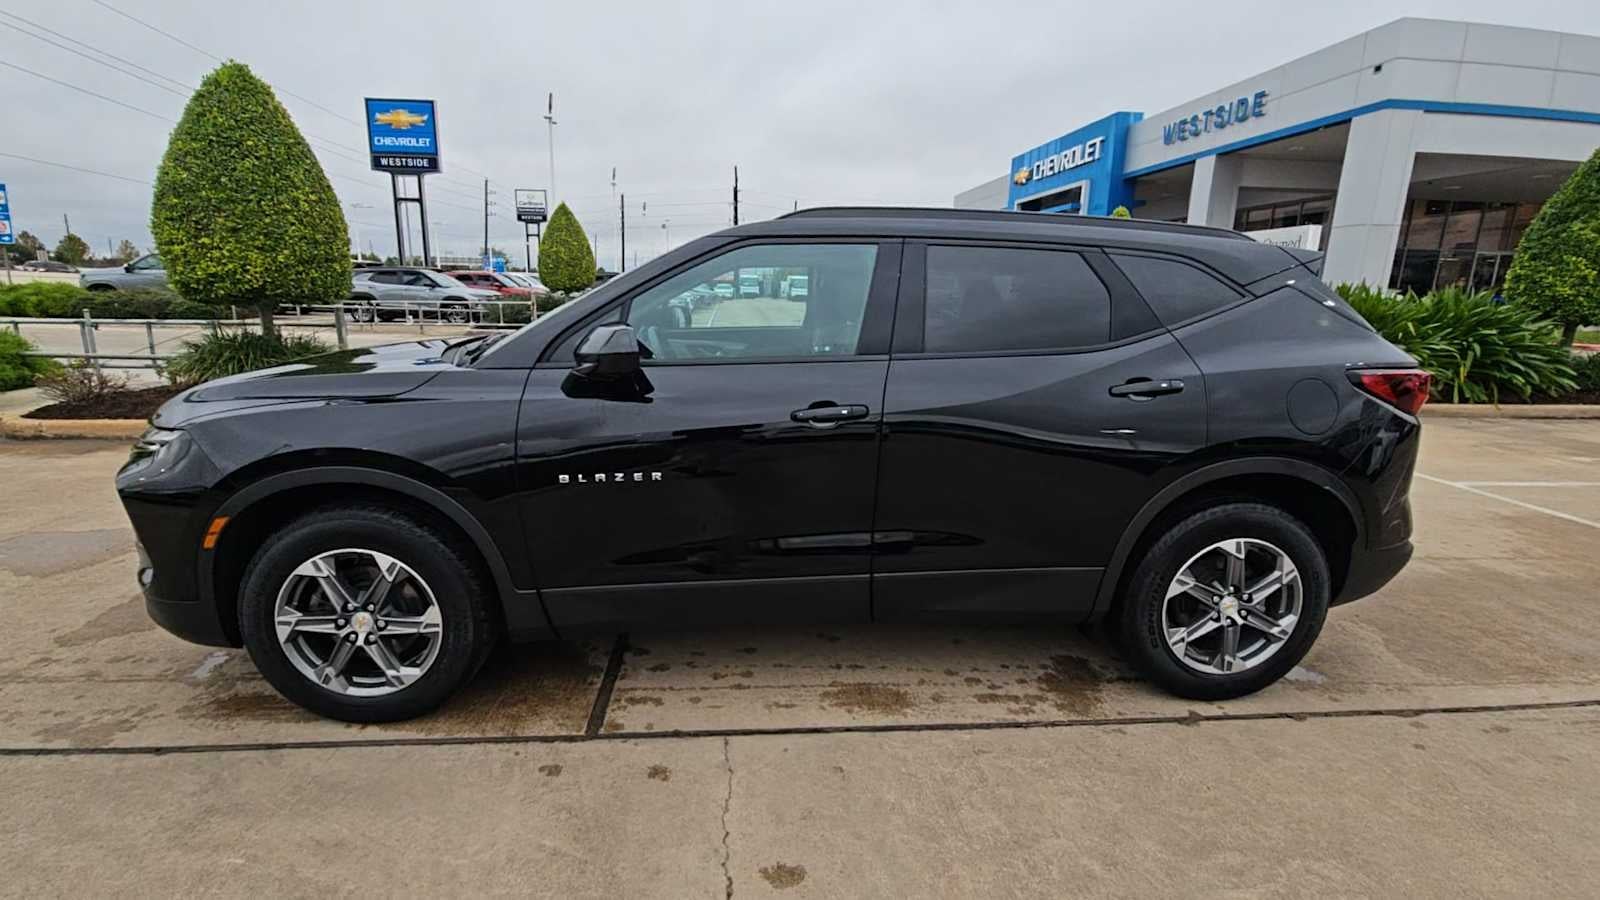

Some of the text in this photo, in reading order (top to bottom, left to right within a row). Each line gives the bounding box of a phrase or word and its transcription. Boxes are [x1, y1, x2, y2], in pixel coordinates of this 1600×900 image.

[1163, 90, 1268, 146] WESTSIDE
[374, 136, 430, 147] CHEVROLET
[380, 158, 429, 167] WESTSIDE
[1033, 137, 1105, 181] CHEVROLET
[558, 472, 662, 483] BLAZER
